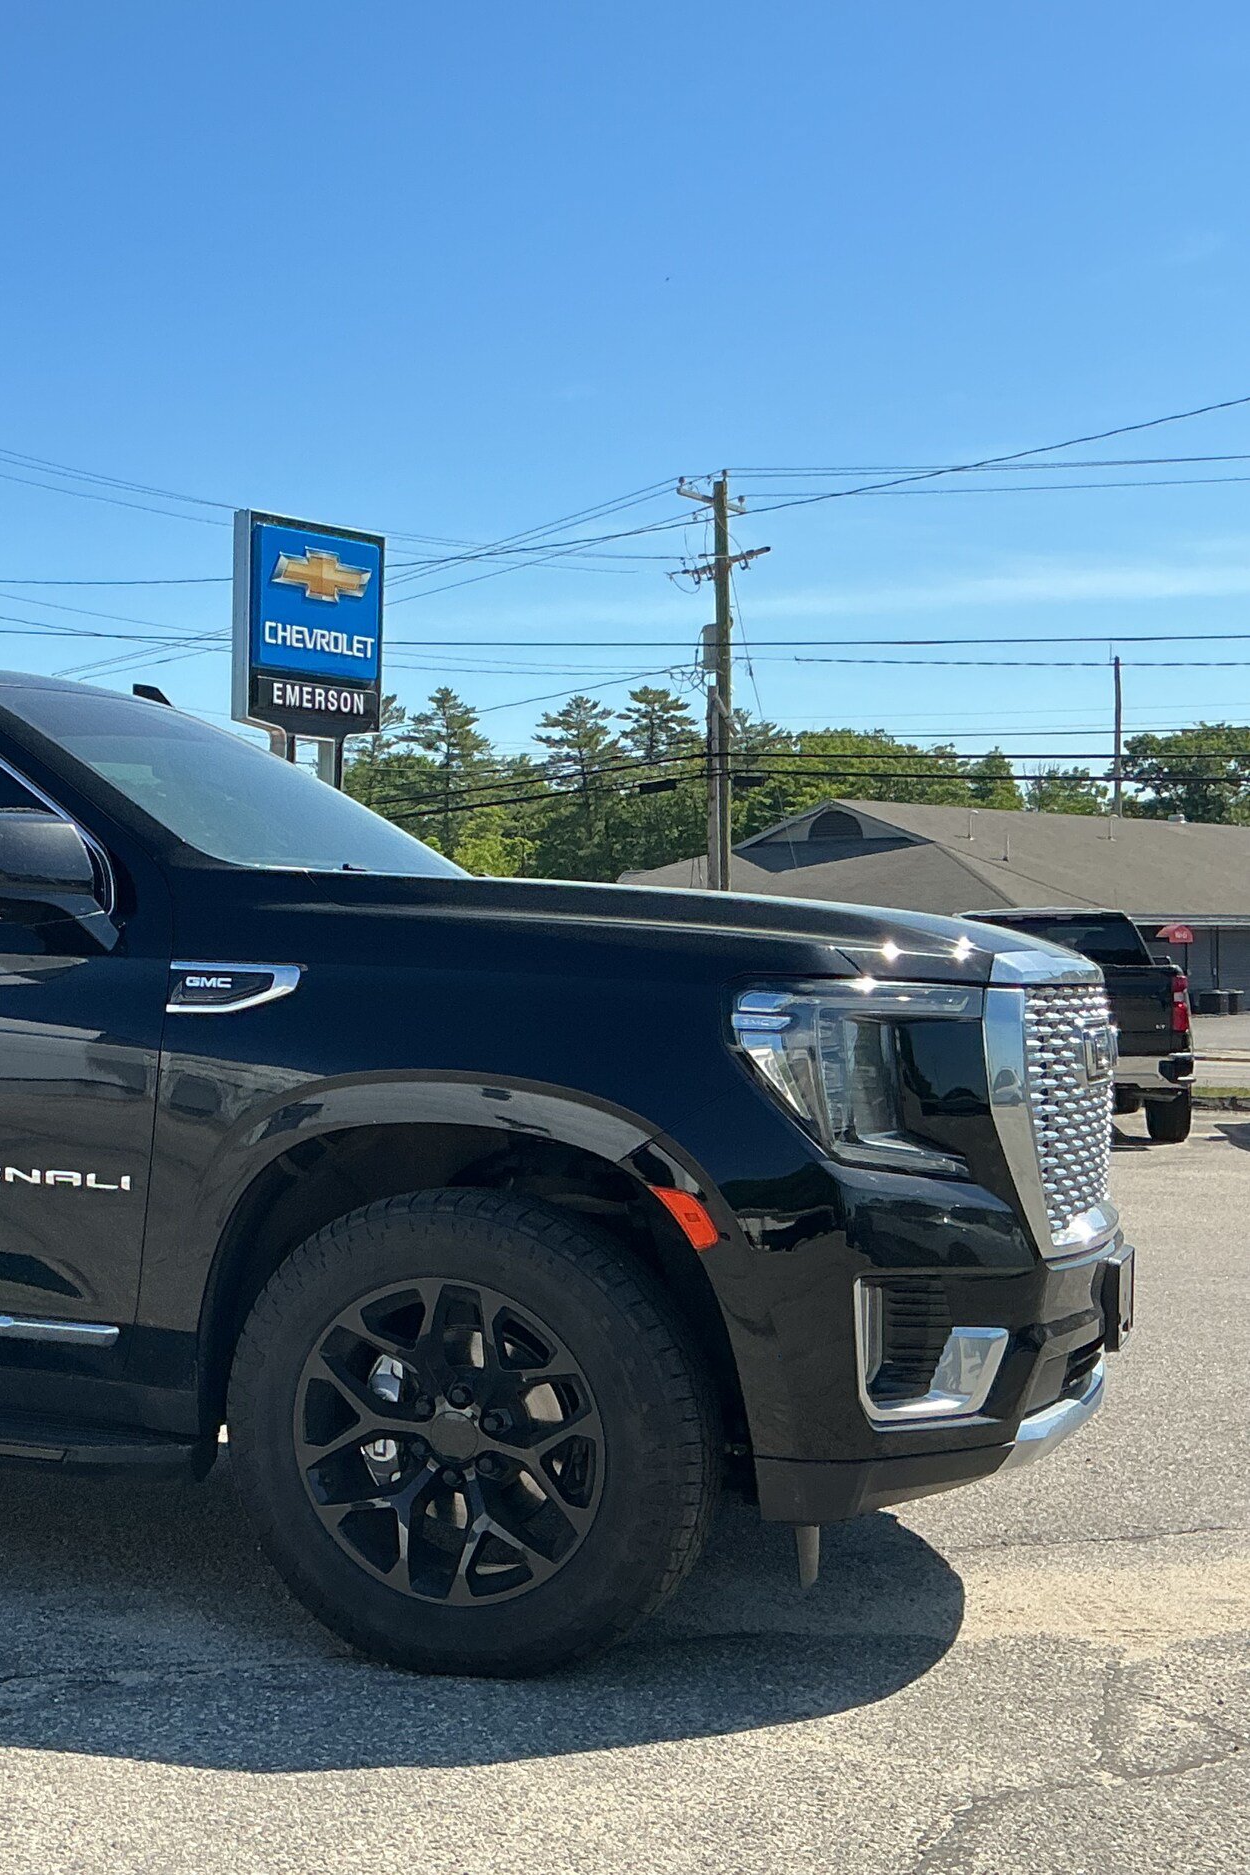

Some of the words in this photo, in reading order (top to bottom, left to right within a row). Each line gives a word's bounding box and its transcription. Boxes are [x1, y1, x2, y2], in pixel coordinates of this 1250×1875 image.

[264, 620, 375, 658] CHEVROLET
[272, 682, 364, 715] EMERSON
[185, 976, 232, 988] GMC
